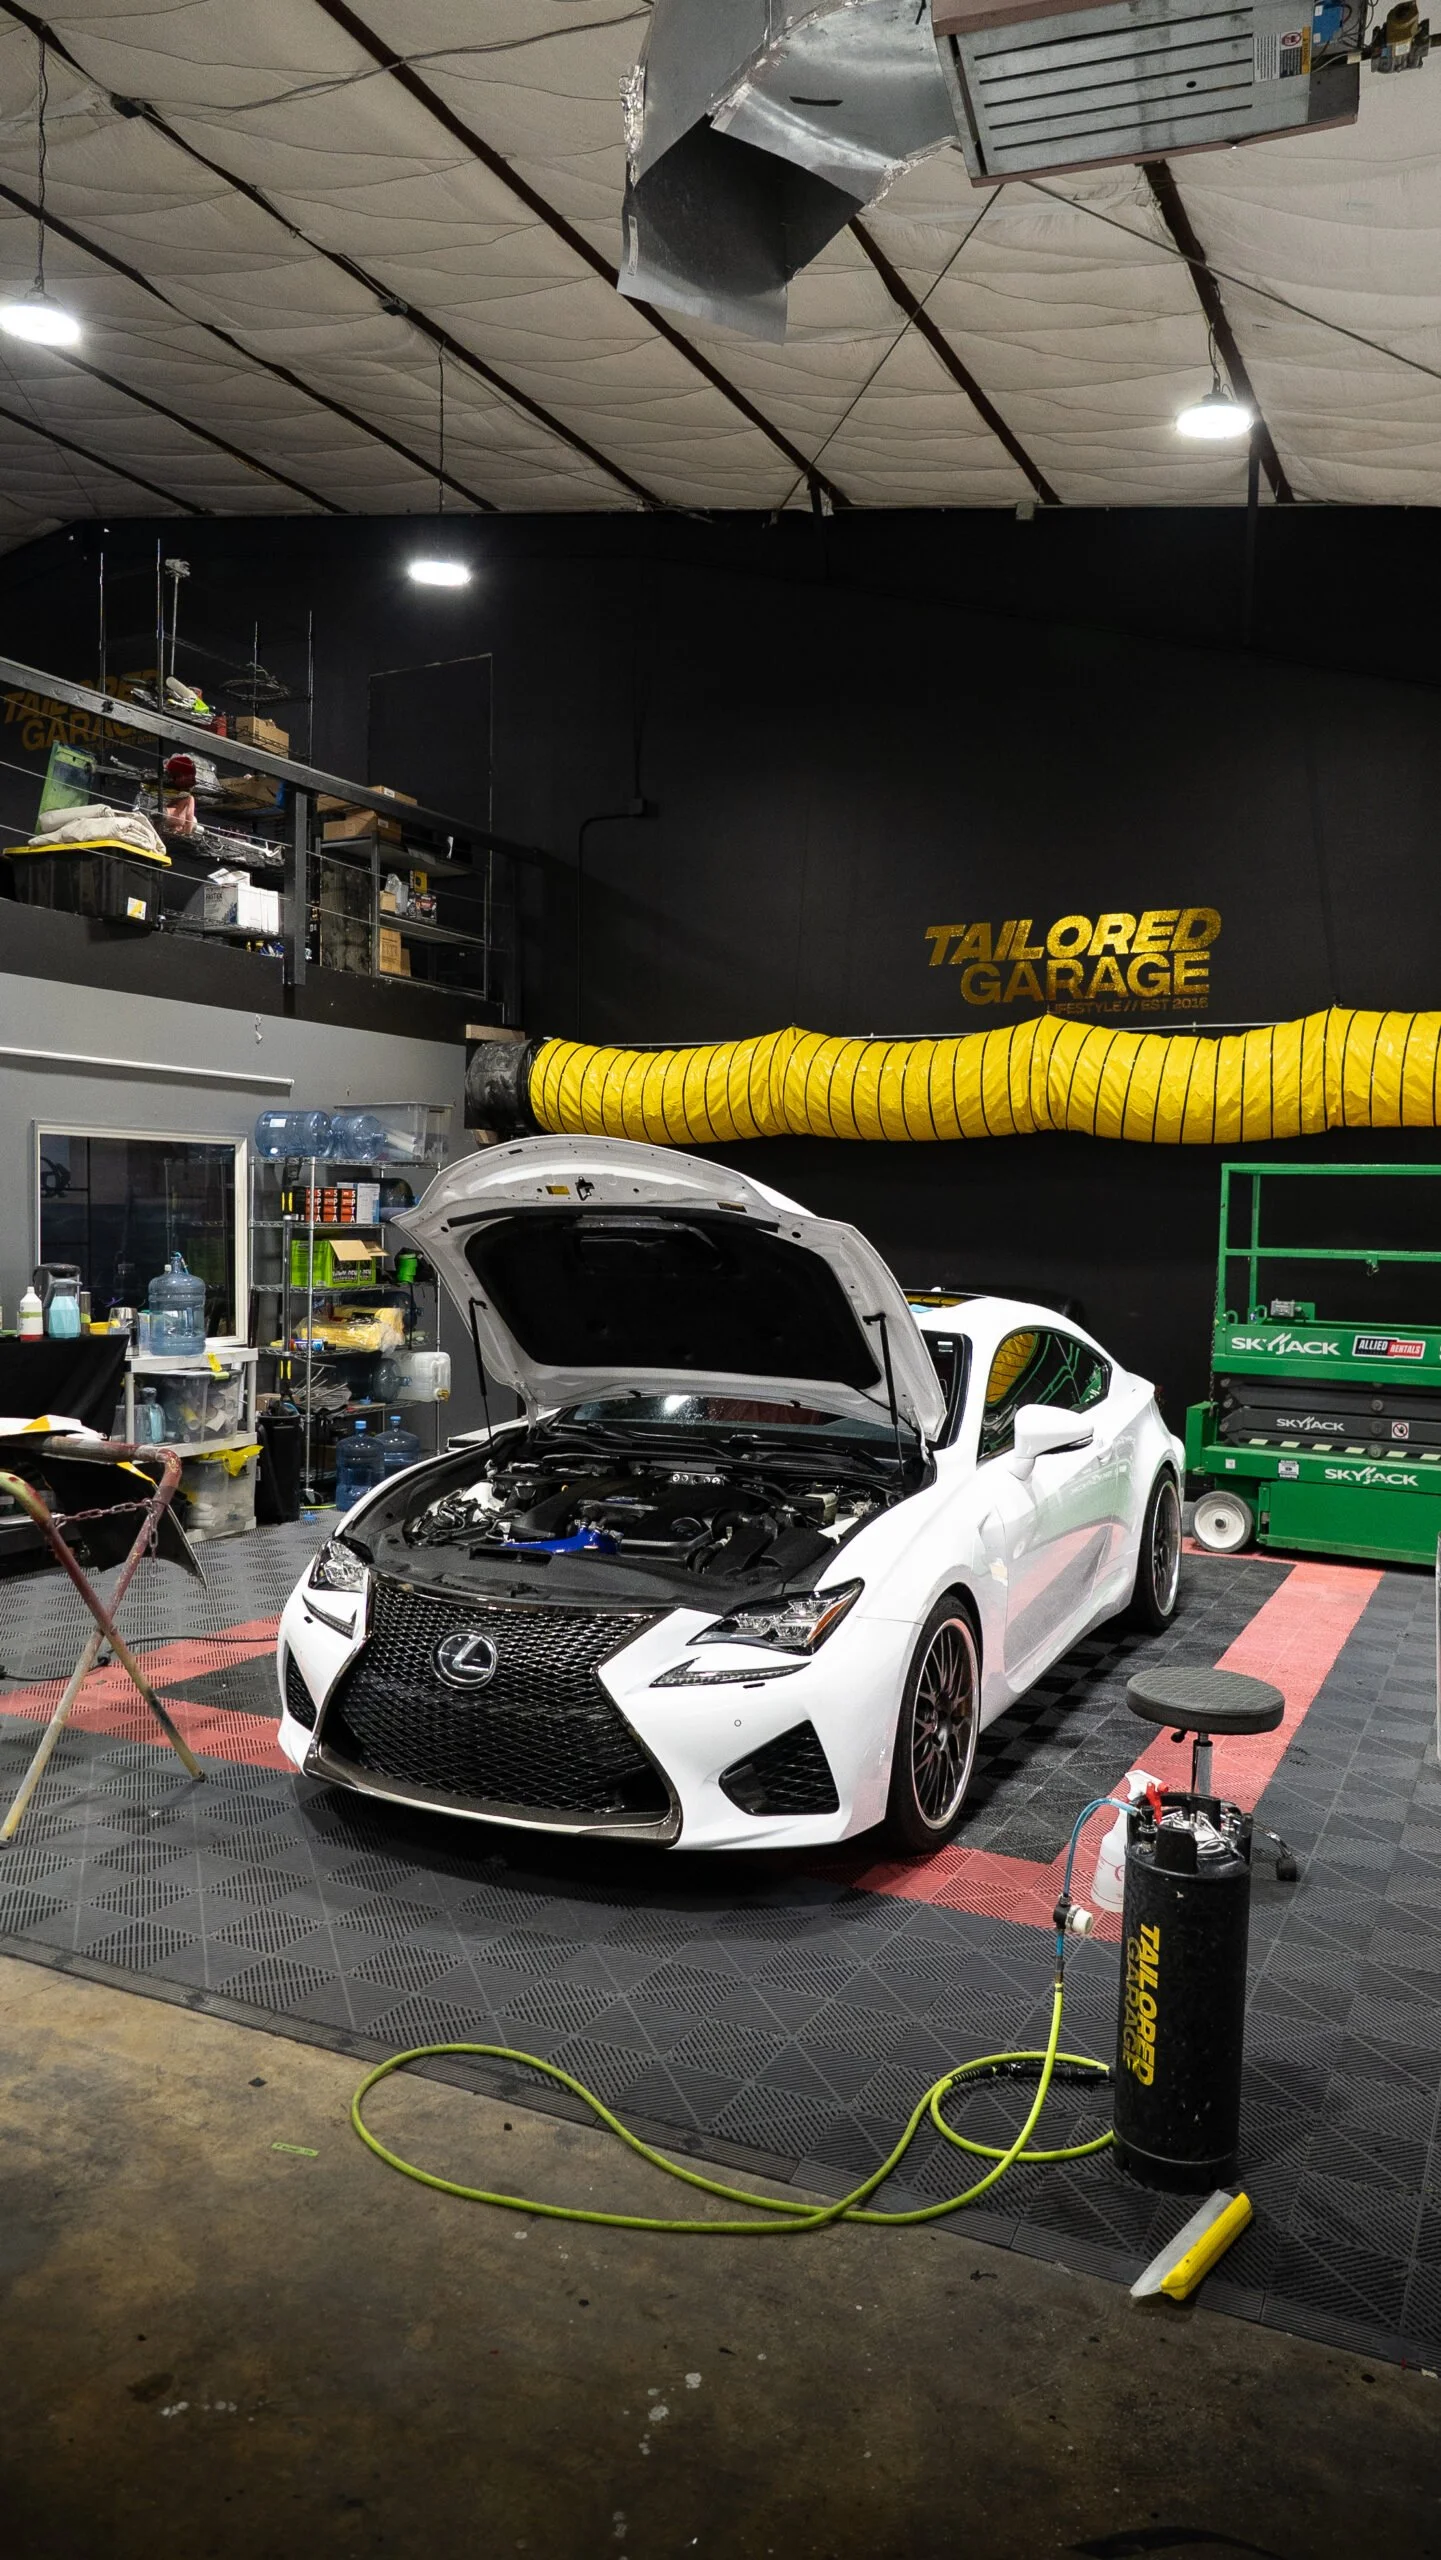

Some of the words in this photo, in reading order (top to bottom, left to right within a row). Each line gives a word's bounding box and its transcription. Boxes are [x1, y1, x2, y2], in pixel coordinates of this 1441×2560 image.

[924, 907, 1222, 966] TAILORED
[960, 951, 1211, 1005] GARAGE
[1231, 1333, 1341, 1355] SKYJACK
[1358, 1339, 1388, 1351] ALLIED
[1389, 1344, 1421, 1354] RENTALS
[1276, 1417, 1345, 1432] SKYJACK
[1324, 1466, 1419, 1487] SKYJACK
[1122, 1936, 1140, 2072] GARAGE
[1137, 1923, 1160, 2086] TAILORED
